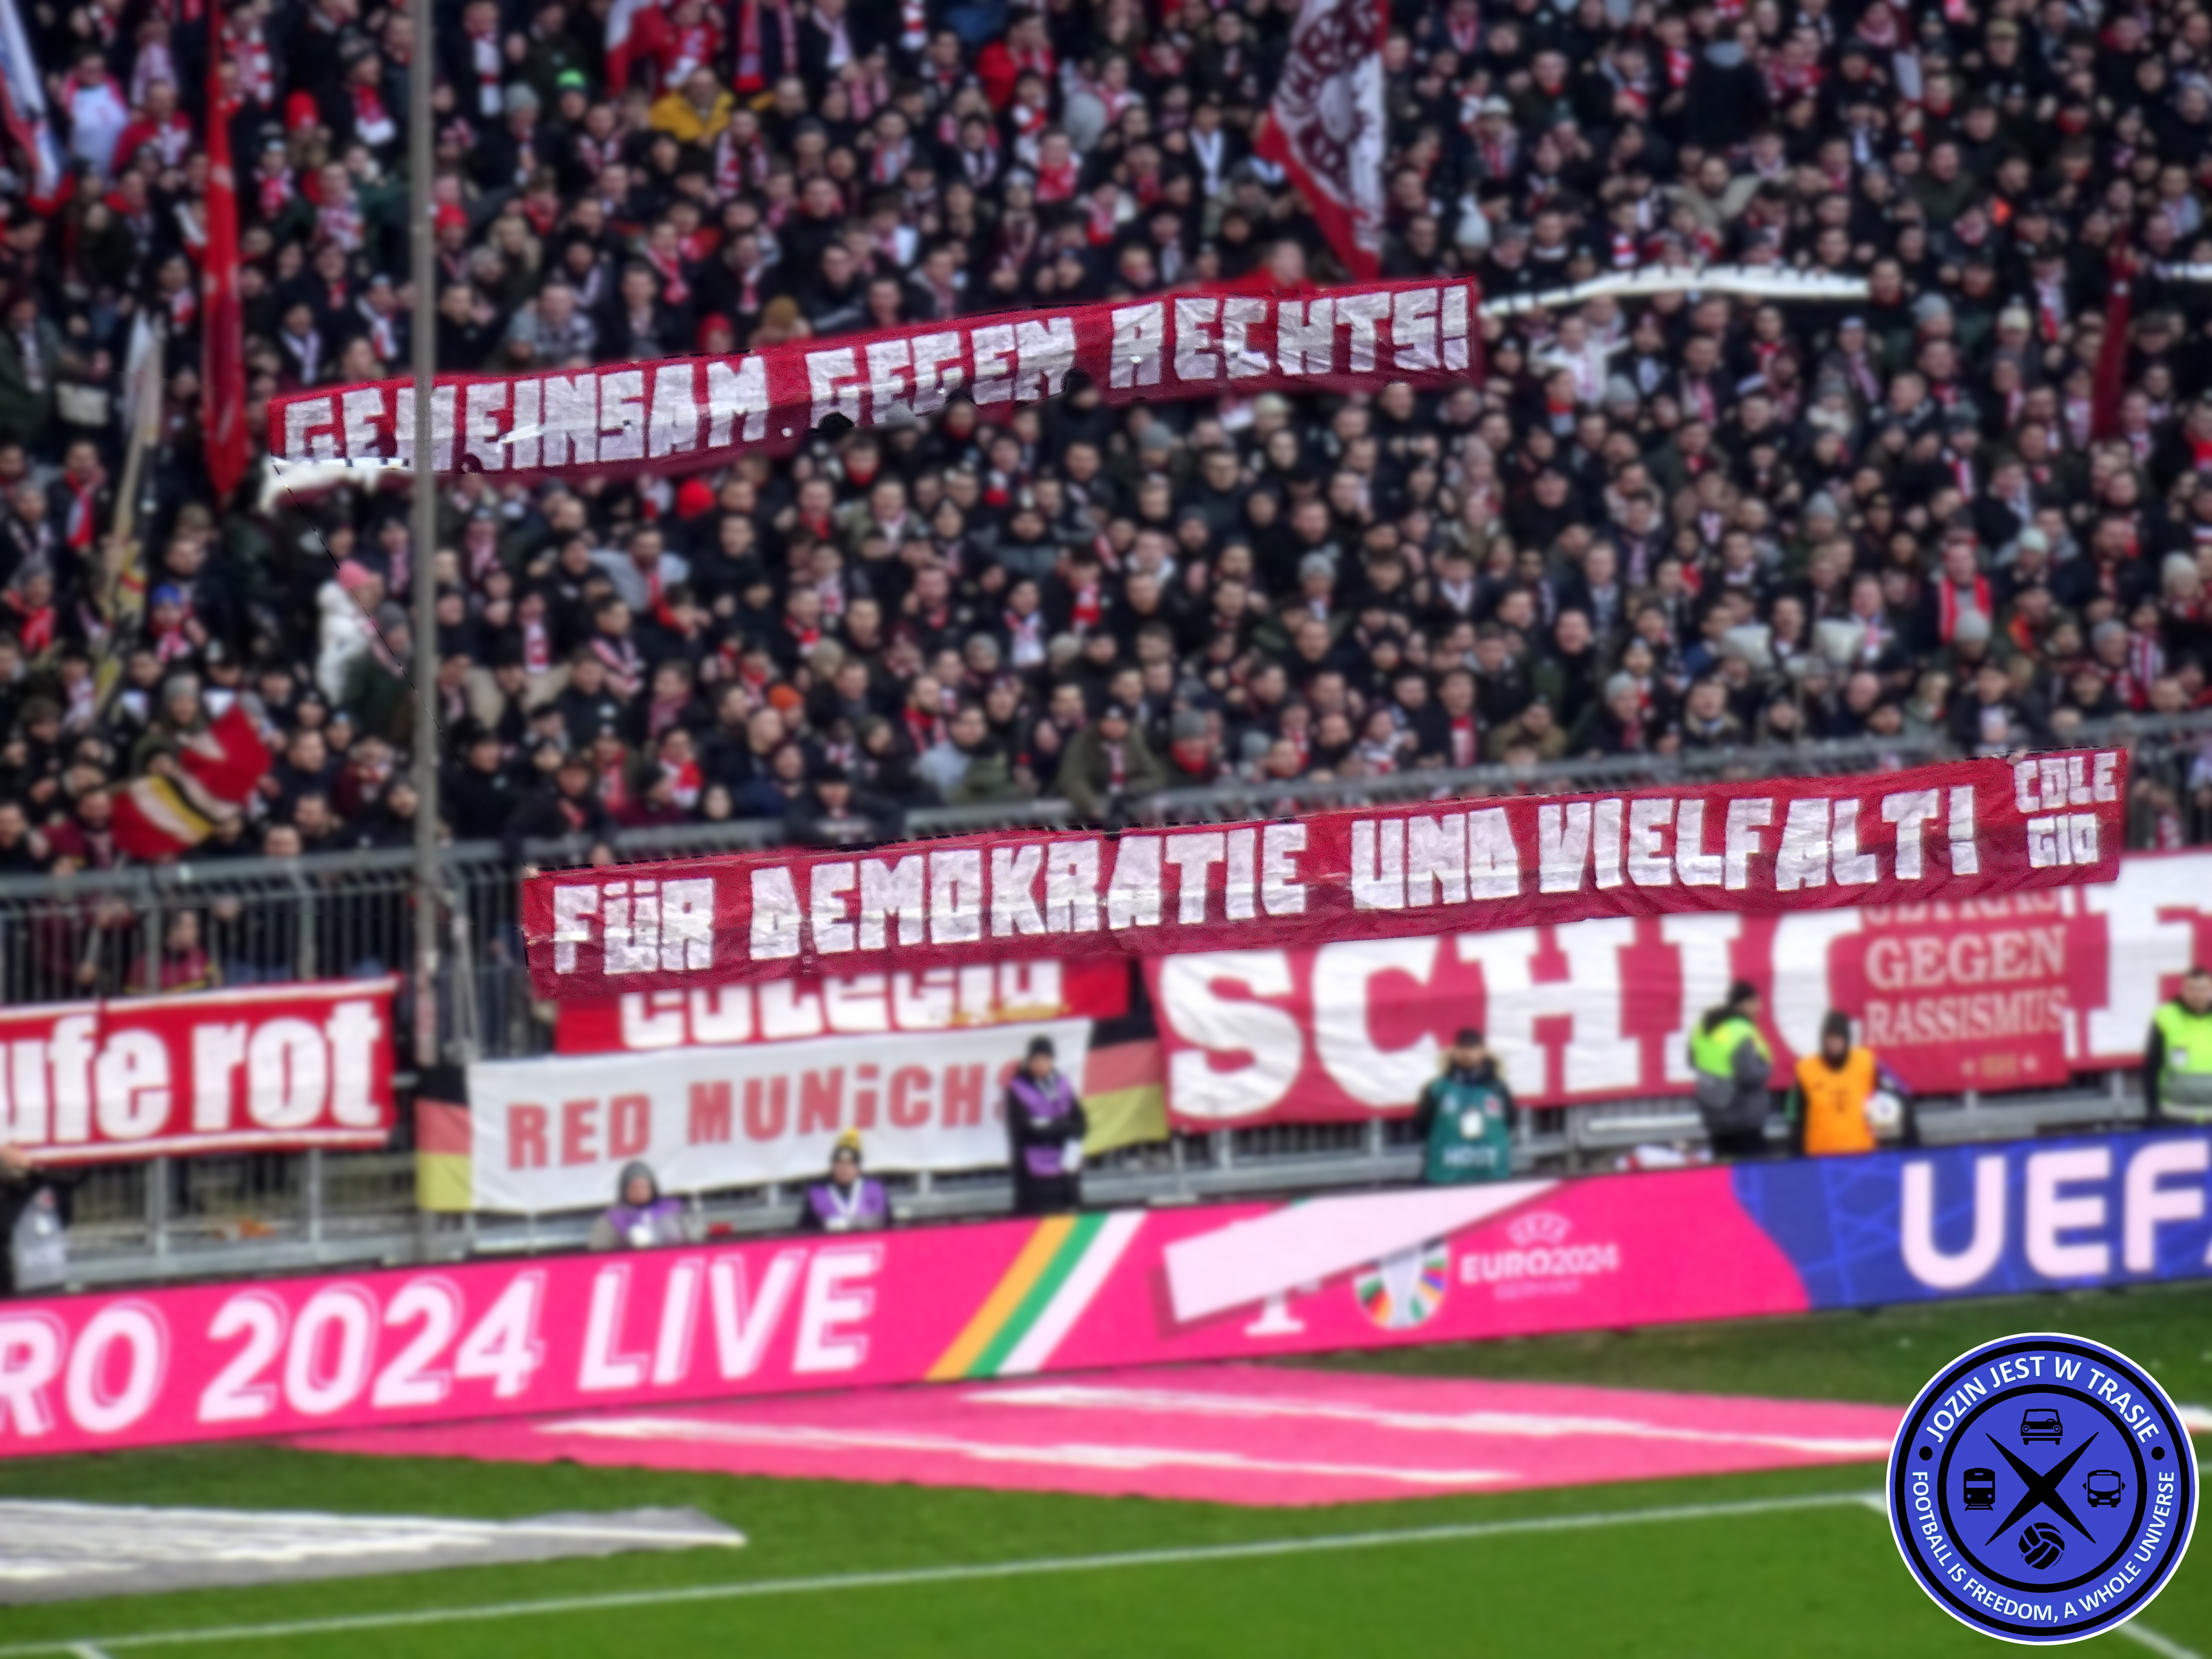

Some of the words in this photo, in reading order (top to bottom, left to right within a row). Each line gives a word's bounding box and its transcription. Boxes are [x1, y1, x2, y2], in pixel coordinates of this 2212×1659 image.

[285, 355, 767, 472] GEMEINSAM
[805, 316, 1076, 427] GEGEN
[1109, 285, 1470, 388] RECHTS!
[2014, 752, 2117, 814] COLE
[553, 877, 715, 975] FÜR
[750, 824, 1306, 960] DEMOKRATIE
[1351, 806, 1520, 911] UND
[1538, 786, 1978, 893] VIELFALT!
[2027, 812, 2099, 868] GIO
[1865, 925, 2068, 990] GEGEN
[191, 999, 382, 1132] rot
[1864, 986, 2067, 1048] RASSISMUS
[506, 1093, 652, 1171] RED
[1900, 1138, 2212, 1289] UEF
[198, 1268, 547, 1423] 2024
[577, 1242, 886, 1392] LIVE
